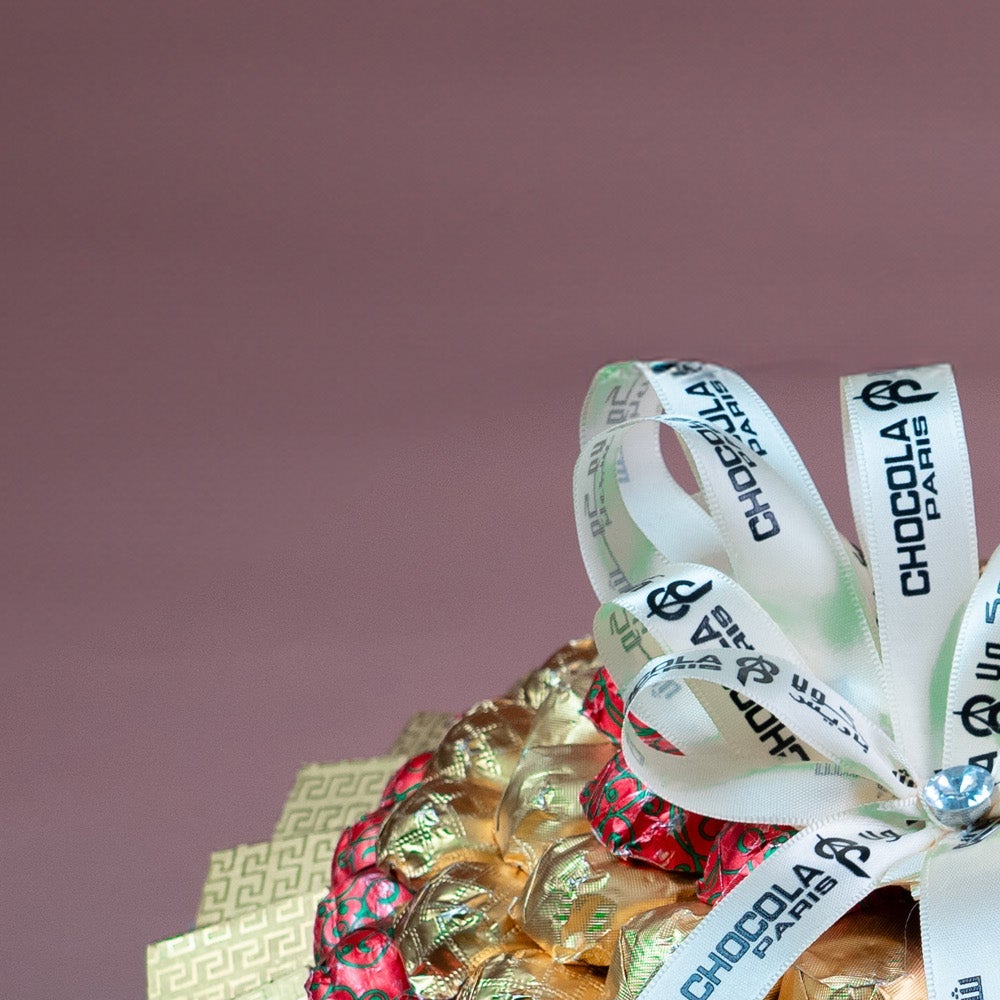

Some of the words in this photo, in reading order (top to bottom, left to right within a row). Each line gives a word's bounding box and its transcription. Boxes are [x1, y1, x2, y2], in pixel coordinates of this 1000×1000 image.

[880, 418, 931, 597] CHOCOLA
[912, 415, 941, 521] PARIS
[752, 875, 839, 959] PARIS
